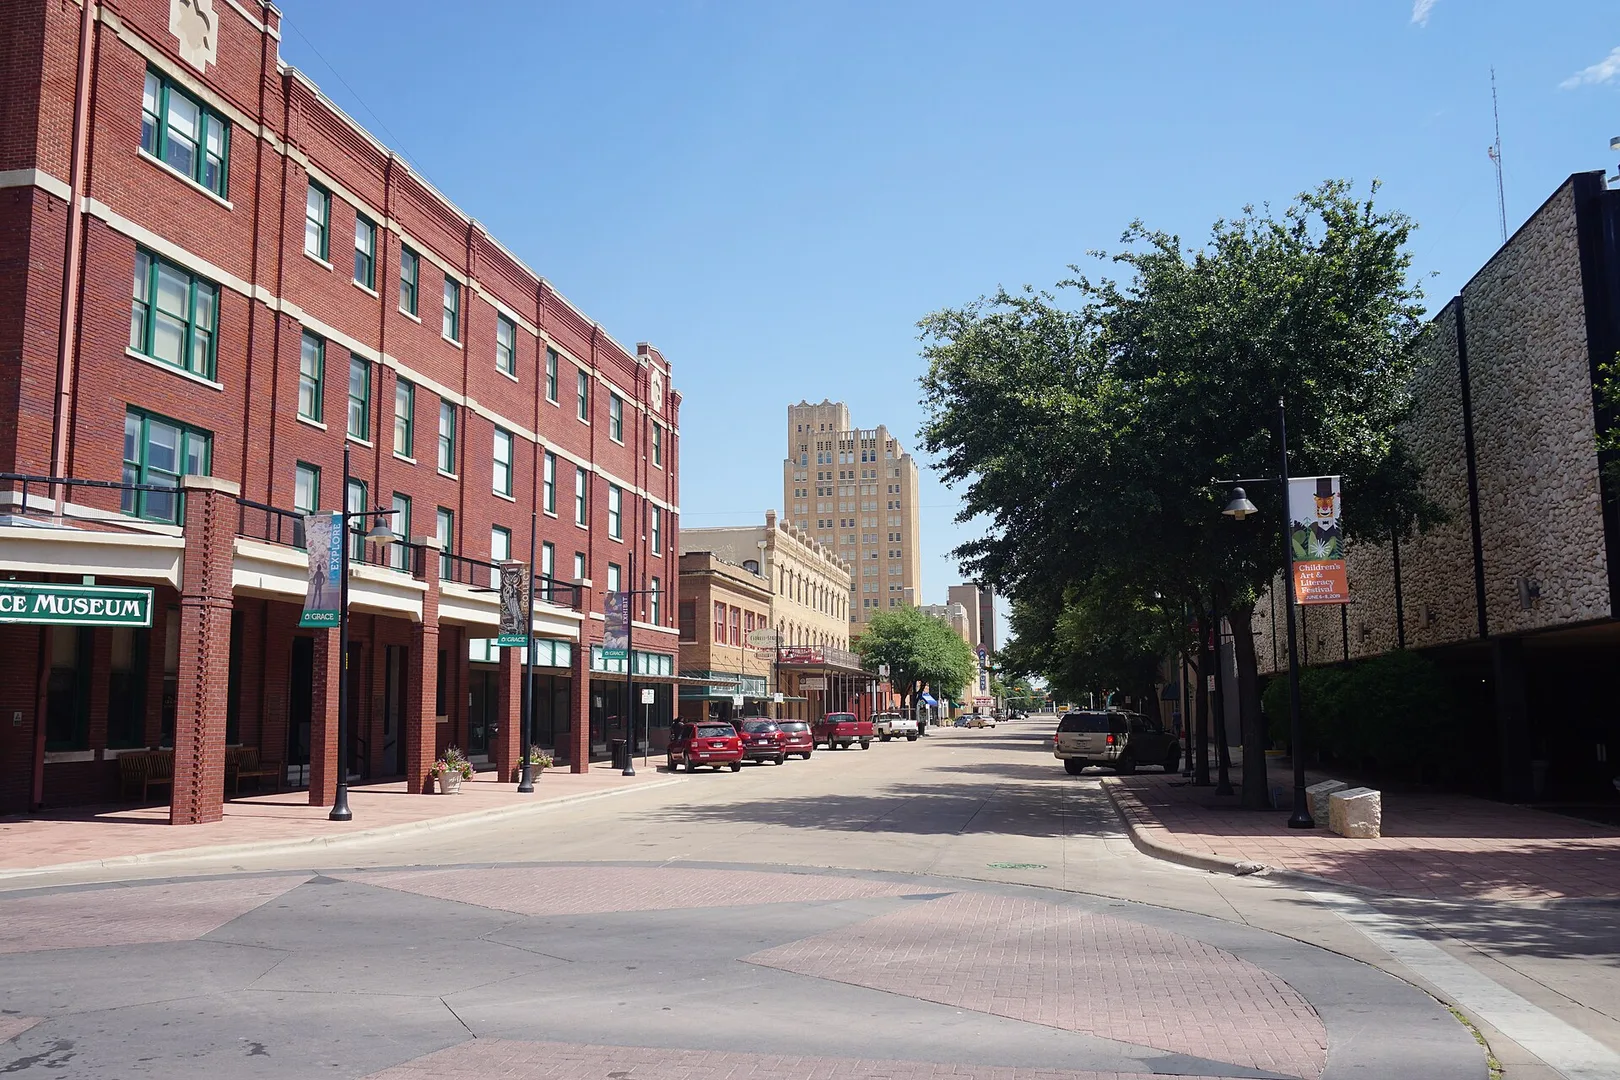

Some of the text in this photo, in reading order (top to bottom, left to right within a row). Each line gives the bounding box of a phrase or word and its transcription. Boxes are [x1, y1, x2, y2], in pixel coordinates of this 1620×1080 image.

[330, 523, 341, 571] EXPLORE
[1299, 563, 1341, 571] Children's
[522, 568, 530, 607] COLLECT
[1300, 579, 1335, 587] Literacy
[1301, 585, 1333, 594] Festival
[0, 594, 141, 617] CE MUSEUM
